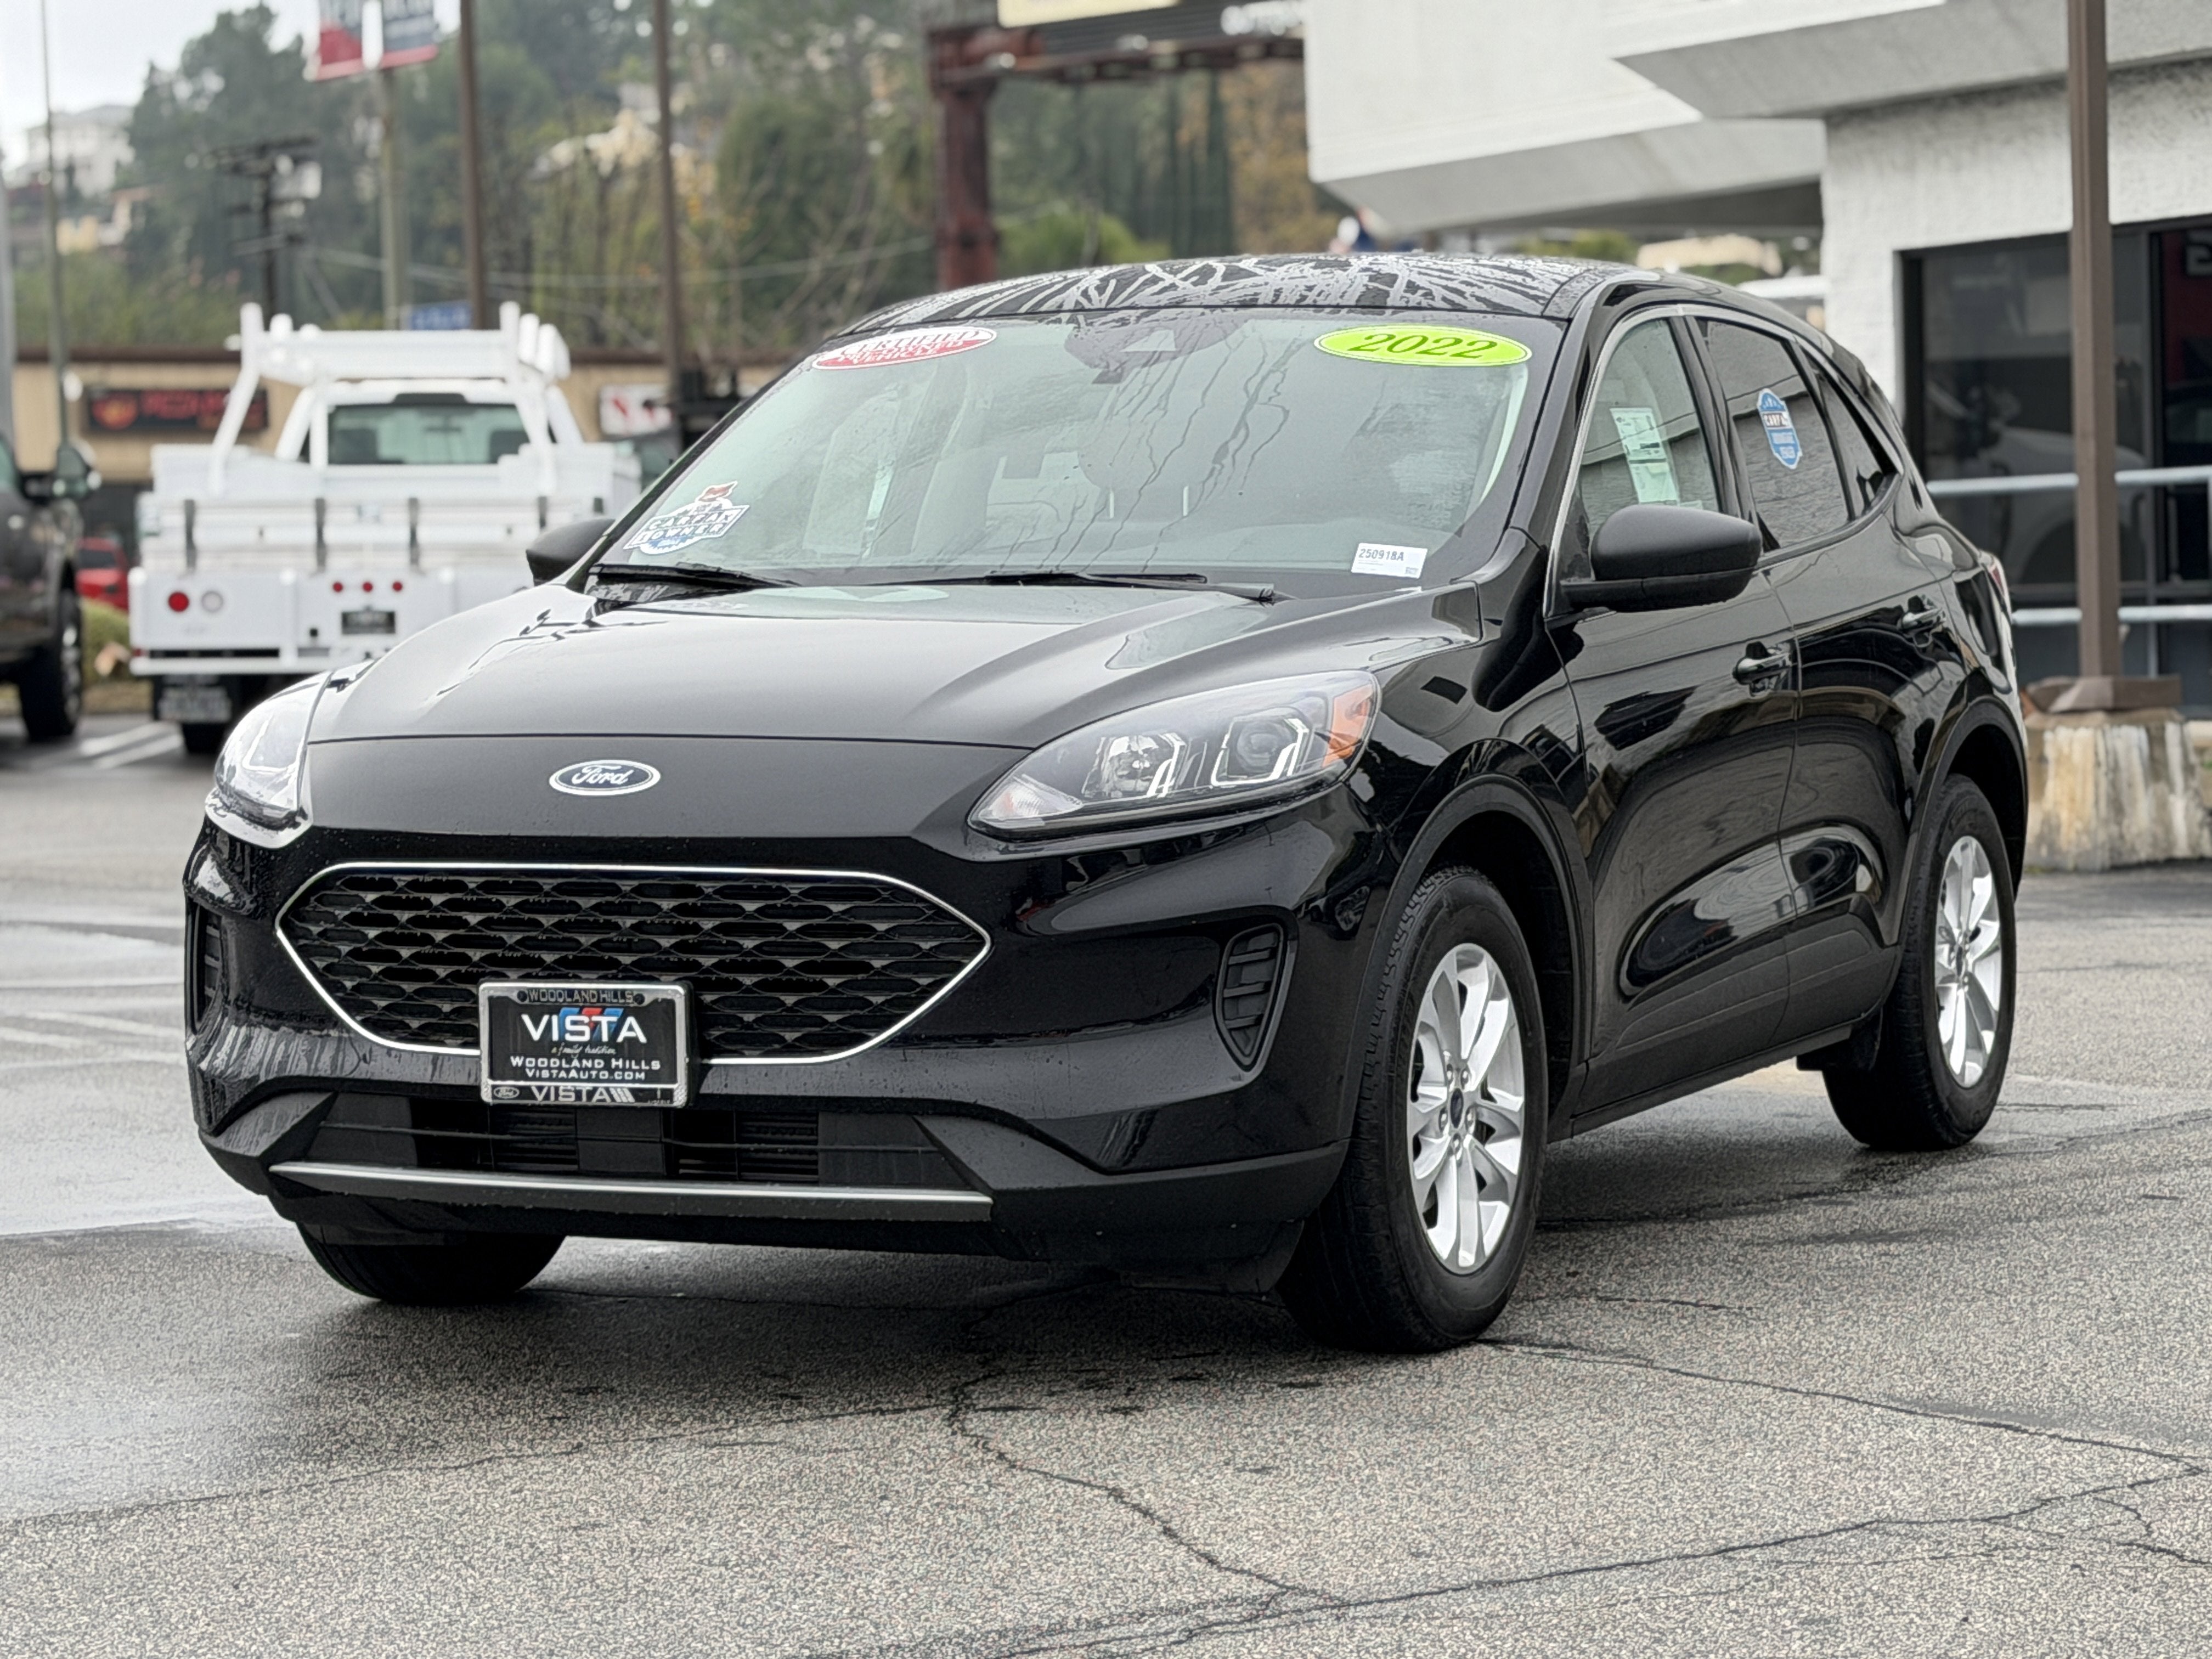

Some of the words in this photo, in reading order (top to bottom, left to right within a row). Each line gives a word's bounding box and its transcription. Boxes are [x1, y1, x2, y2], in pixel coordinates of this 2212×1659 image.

[840, 330, 980, 355] CERTIFIED
[1347, 333, 1498, 358] 2022
[648, 512, 734, 530] CARFAX
[651, 523, 725, 540] OWNER
[1358, 548, 1404, 561] 250918A
[571, 765, 634, 785] Ford
[529, 989, 597, 1002] WOODLAND
[600, 990, 634, 1003] HILLS
[521, 1014, 647, 1043] VISTA
[510, 1056, 605, 1069] WOODLAND
[611, 1058, 661, 1070] HILLS
[531, 1086, 611, 1103] VISTA
